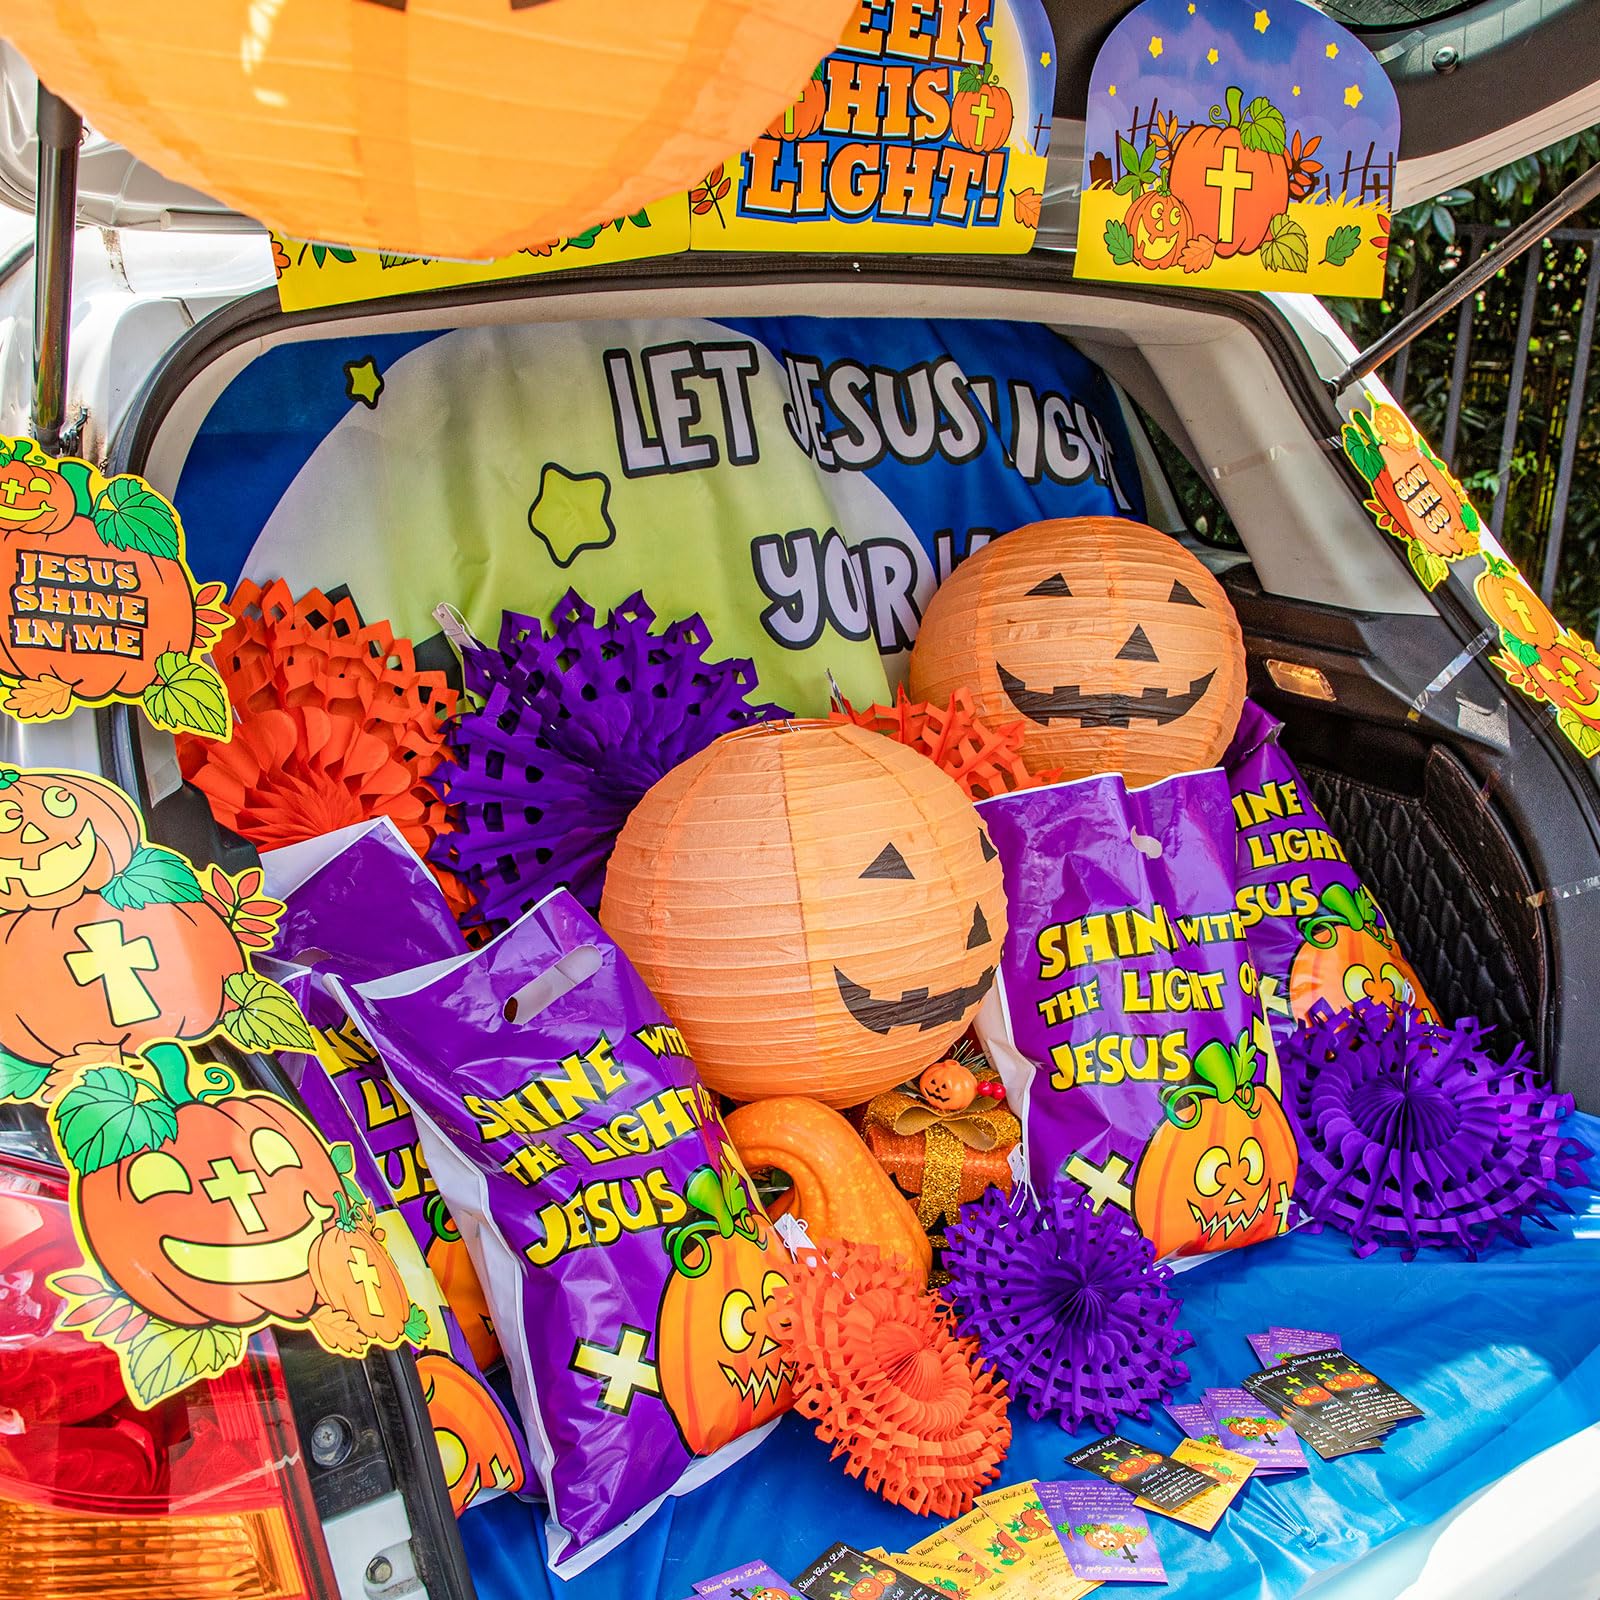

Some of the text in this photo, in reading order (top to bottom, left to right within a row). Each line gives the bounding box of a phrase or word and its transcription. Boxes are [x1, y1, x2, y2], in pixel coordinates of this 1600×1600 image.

[838, 0, 992, 68] EEK
[824, 62, 952, 143] HIS
[740, 138, 1006, 222] LIGHT!
[604, 343, 758, 476] LET
[783, 355, 986, 471] JESUS
[1394, 464, 1428, 502] GLOW
[1407, 483, 1442, 518] WITH
[1424, 503, 1451, 533] GOD
[20, 552, 138, 590] JESUS
[14, 585, 146, 625] SHINE
[13, 617, 142, 657] IN ME
[1231, 780, 1303, 829] INE
[1247, 829, 1347, 868] LIGHT
[1235, 875, 1319, 926] SUS
[1176, 911, 1247, 943] WITH
[1040, 981, 1100, 1026] THE
[1122, 968, 1226, 1013] LIGHT
[1051, 1031, 1191, 1090] JESUS
[464, 1036, 628, 1141] SHINE
[504, 1144, 563, 1185] THE
[569, 1087, 702, 1163] LIGHT
[526, 1170, 689, 1266] JESUS
[970, 1513, 986, 1526] God
[701, 1584, 723, 1595] Shine
[798, 1573, 817, 1593] Shine
[829, 1545, 849, 1563] Light
[894, 1558, 917, 1567] Shine
[944, 1564, 973, 1574] Light
